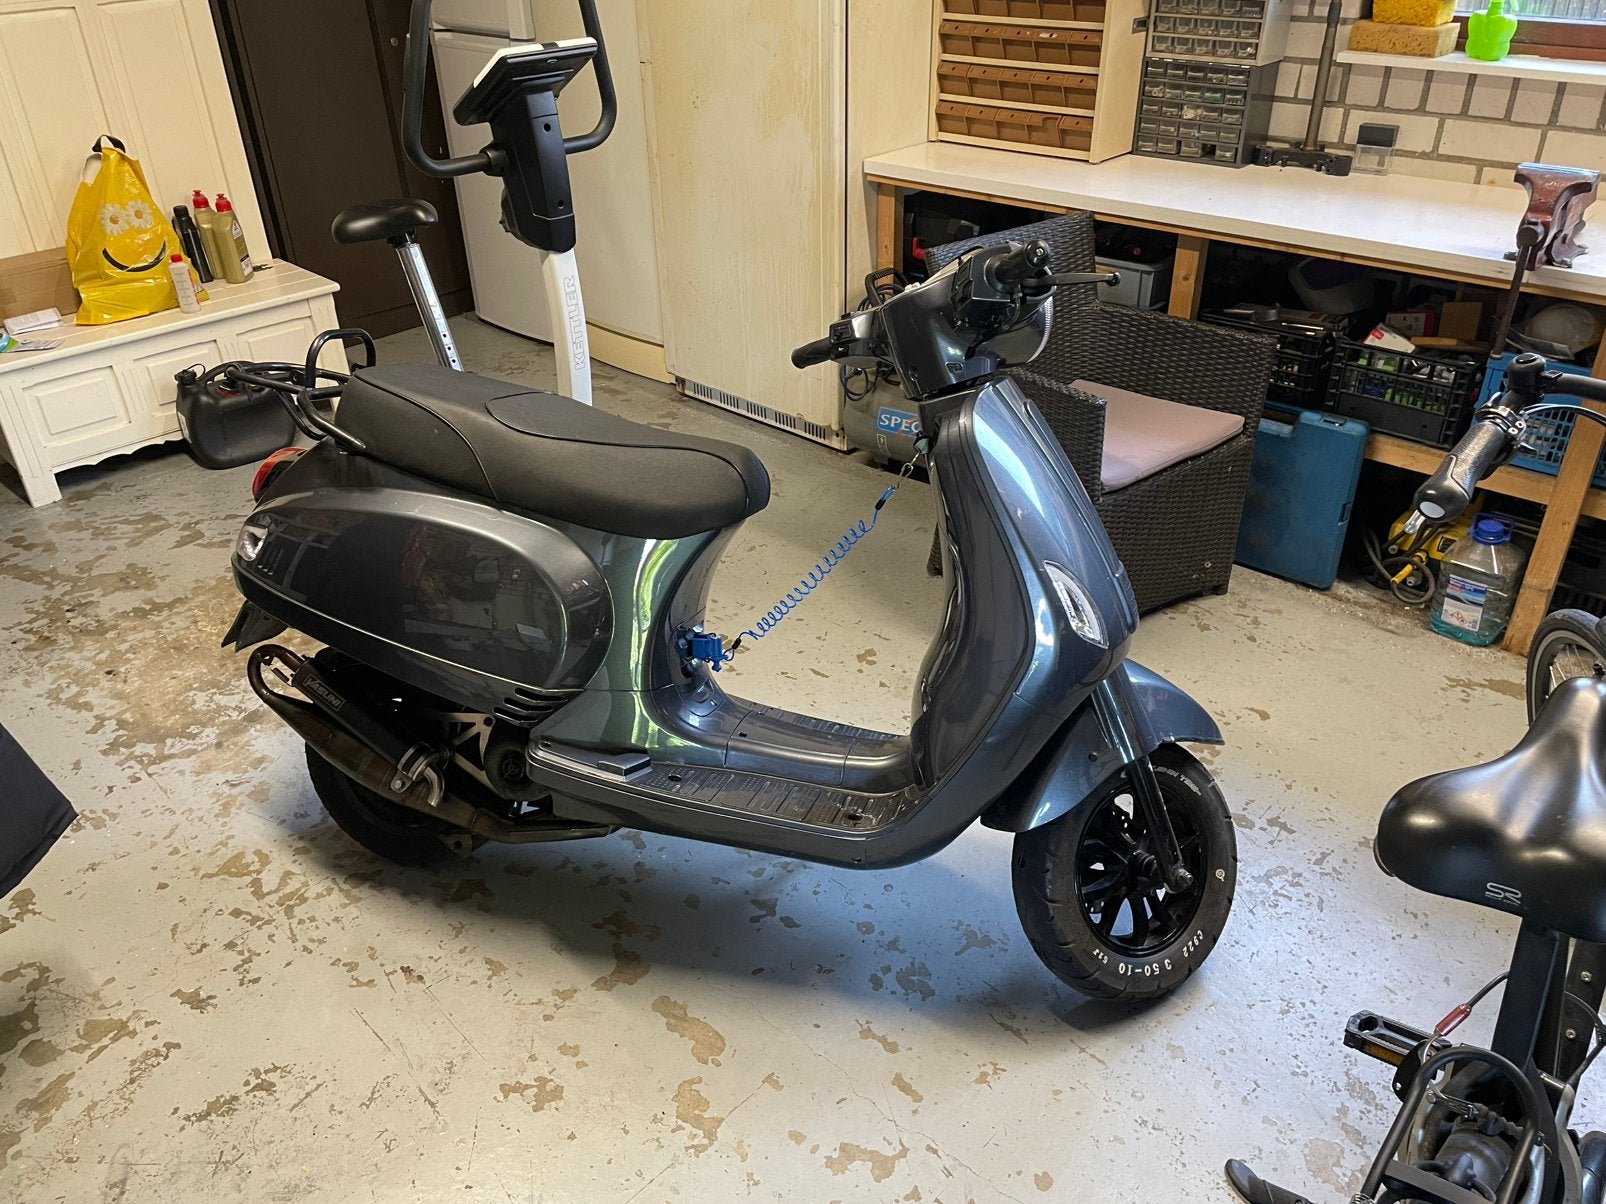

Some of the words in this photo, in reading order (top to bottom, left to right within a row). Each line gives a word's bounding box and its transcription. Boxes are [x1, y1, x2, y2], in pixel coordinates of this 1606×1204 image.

[563, 275, 585, 370] KETTLER
[304, 678, 341, 707] YASUNI
[1182, 930, 1204, 957] C922
